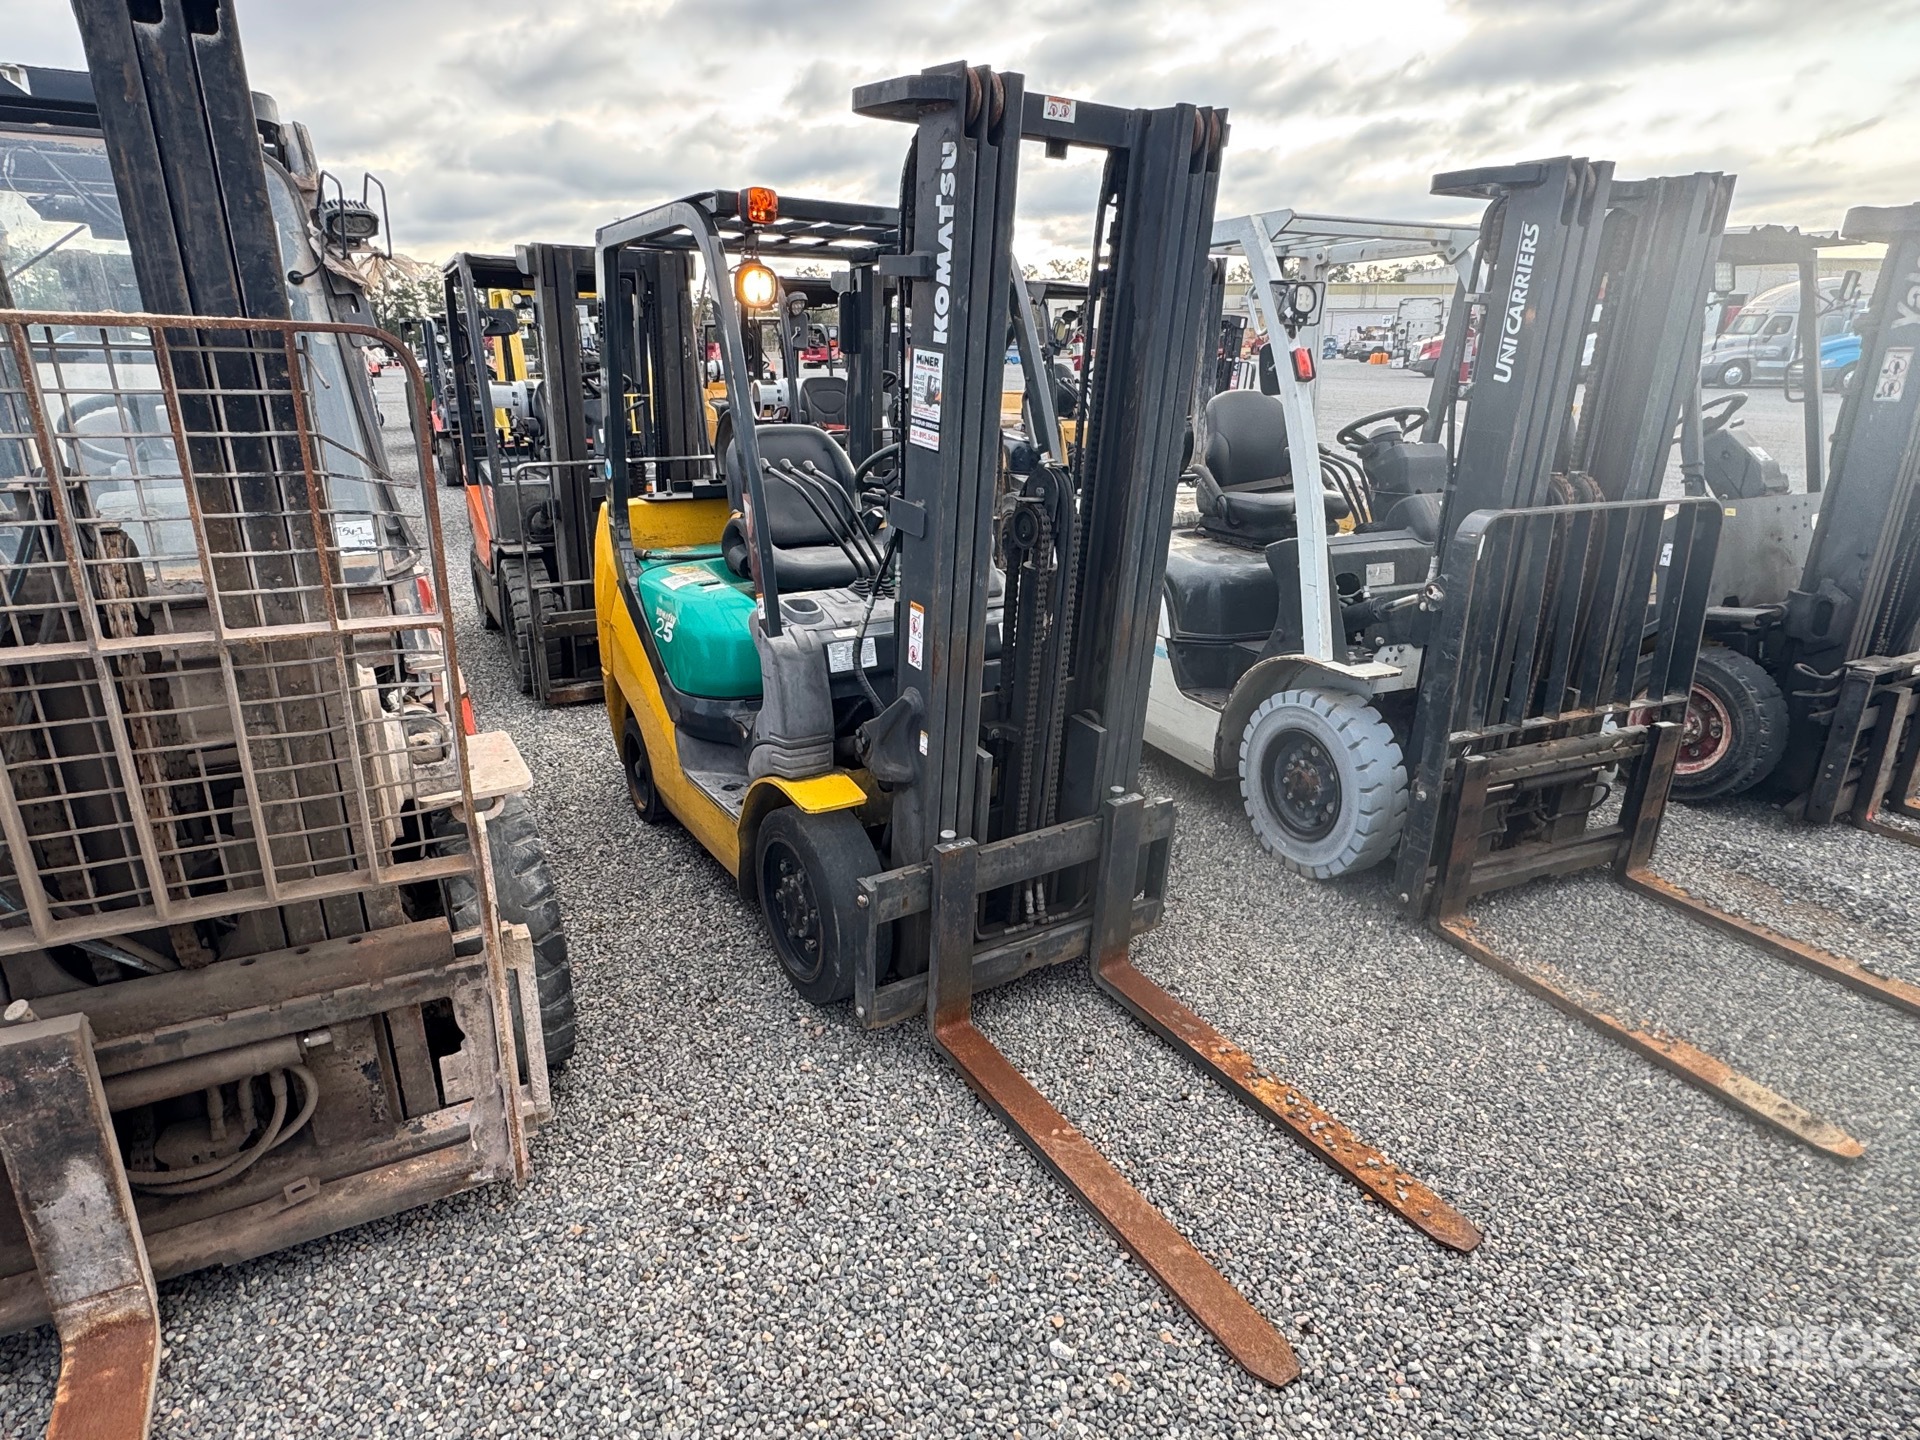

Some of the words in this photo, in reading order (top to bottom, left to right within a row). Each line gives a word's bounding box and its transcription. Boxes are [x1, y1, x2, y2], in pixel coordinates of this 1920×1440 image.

[933, 142, 957, 344] KOMATSU
[1493, 223, 1540, 383] UNICARRIERS
[655, 617, 673, 643] 25
